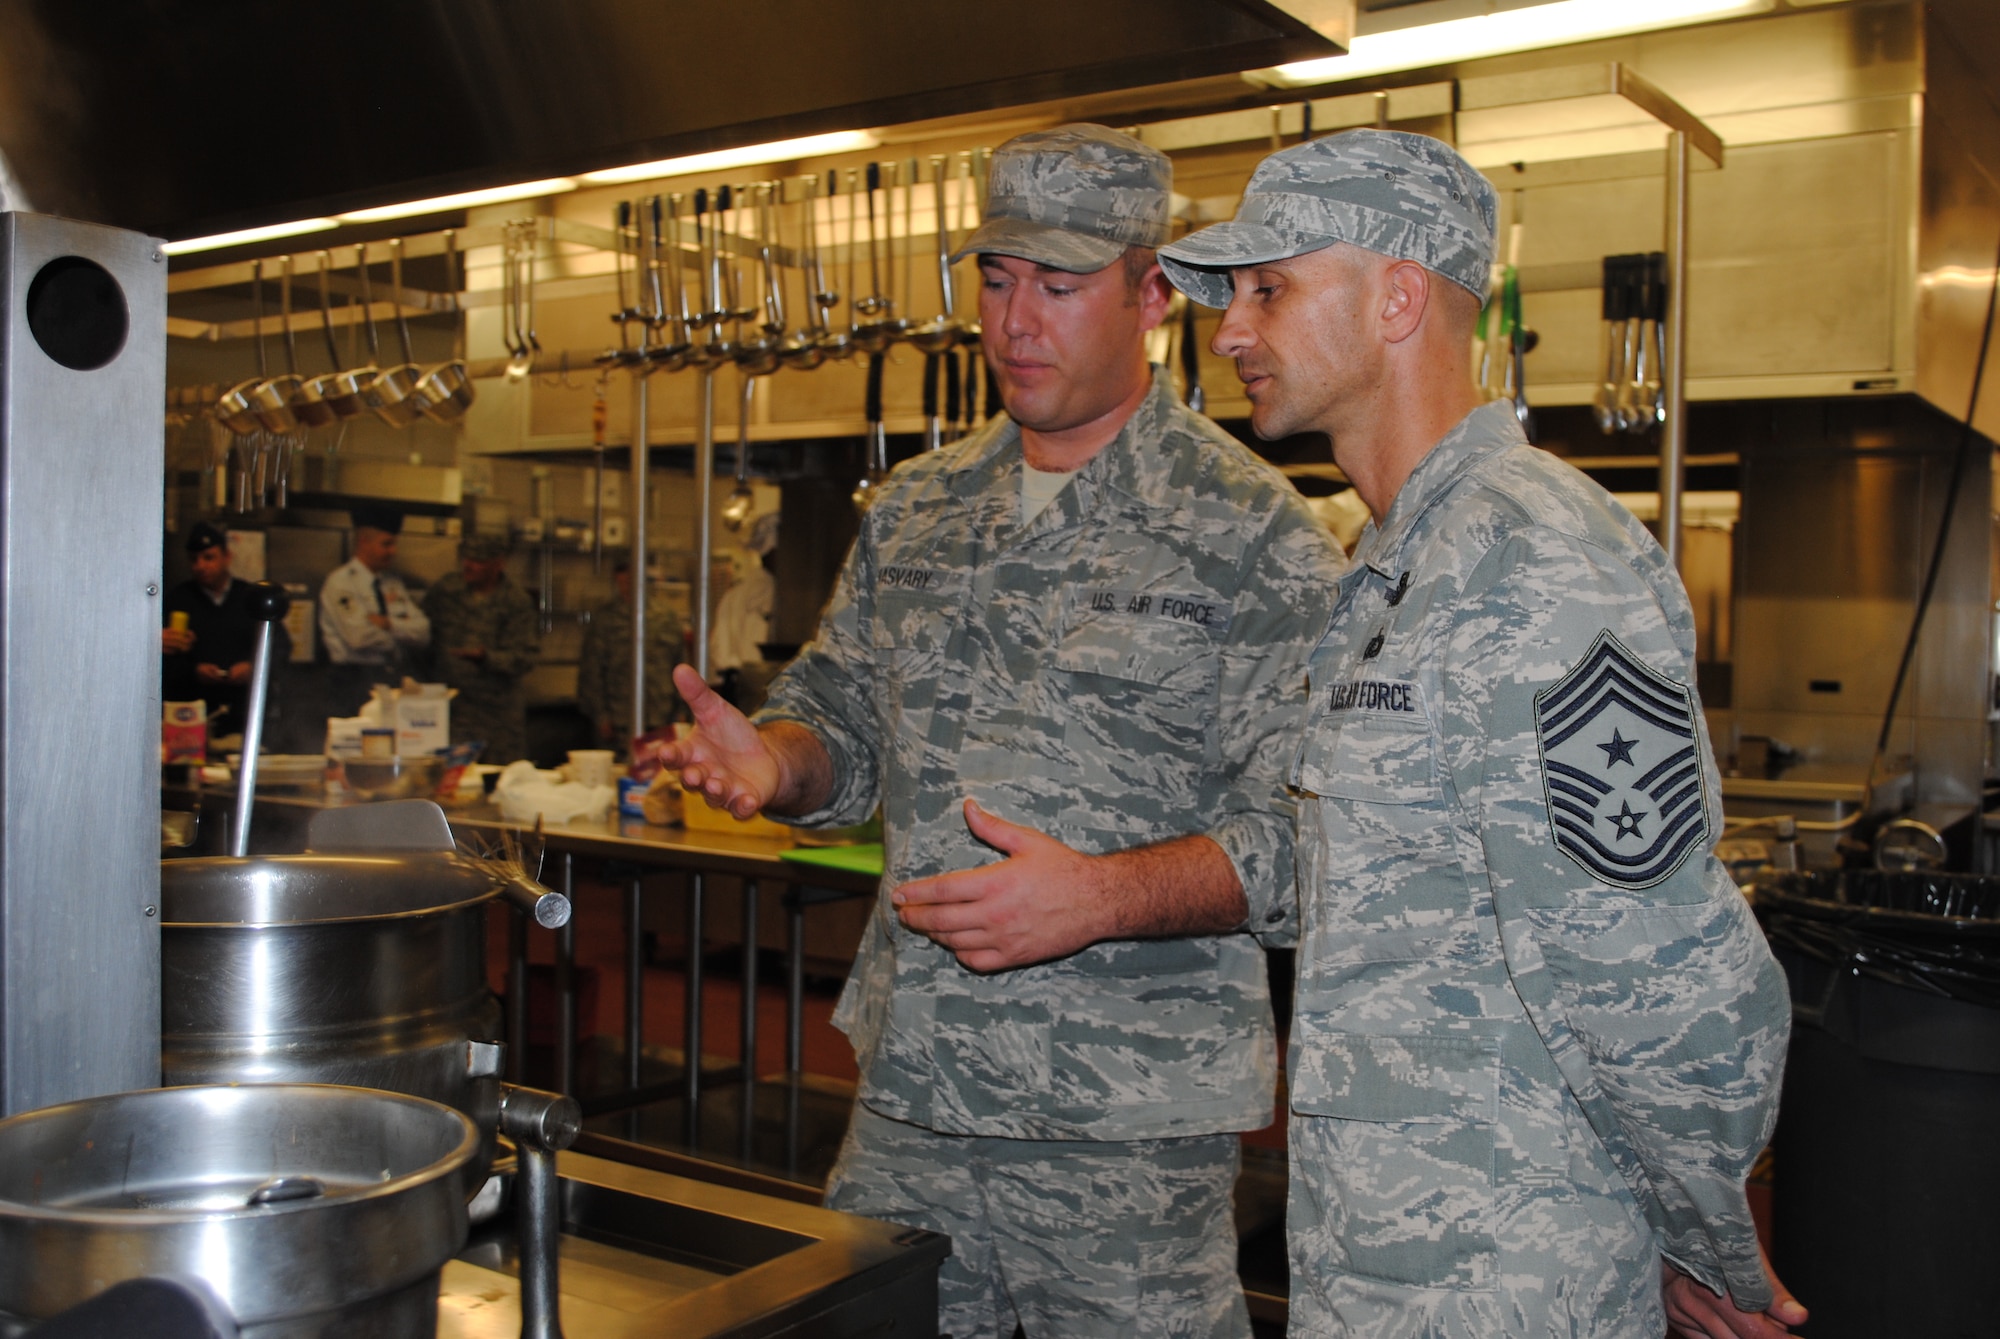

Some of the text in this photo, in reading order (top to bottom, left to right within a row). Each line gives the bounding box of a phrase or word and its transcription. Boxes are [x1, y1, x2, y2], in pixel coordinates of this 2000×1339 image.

[1091, 592, 1215, 624] U.S. AIR FORCE
[1358, 681, 1415, 711] FORCE
